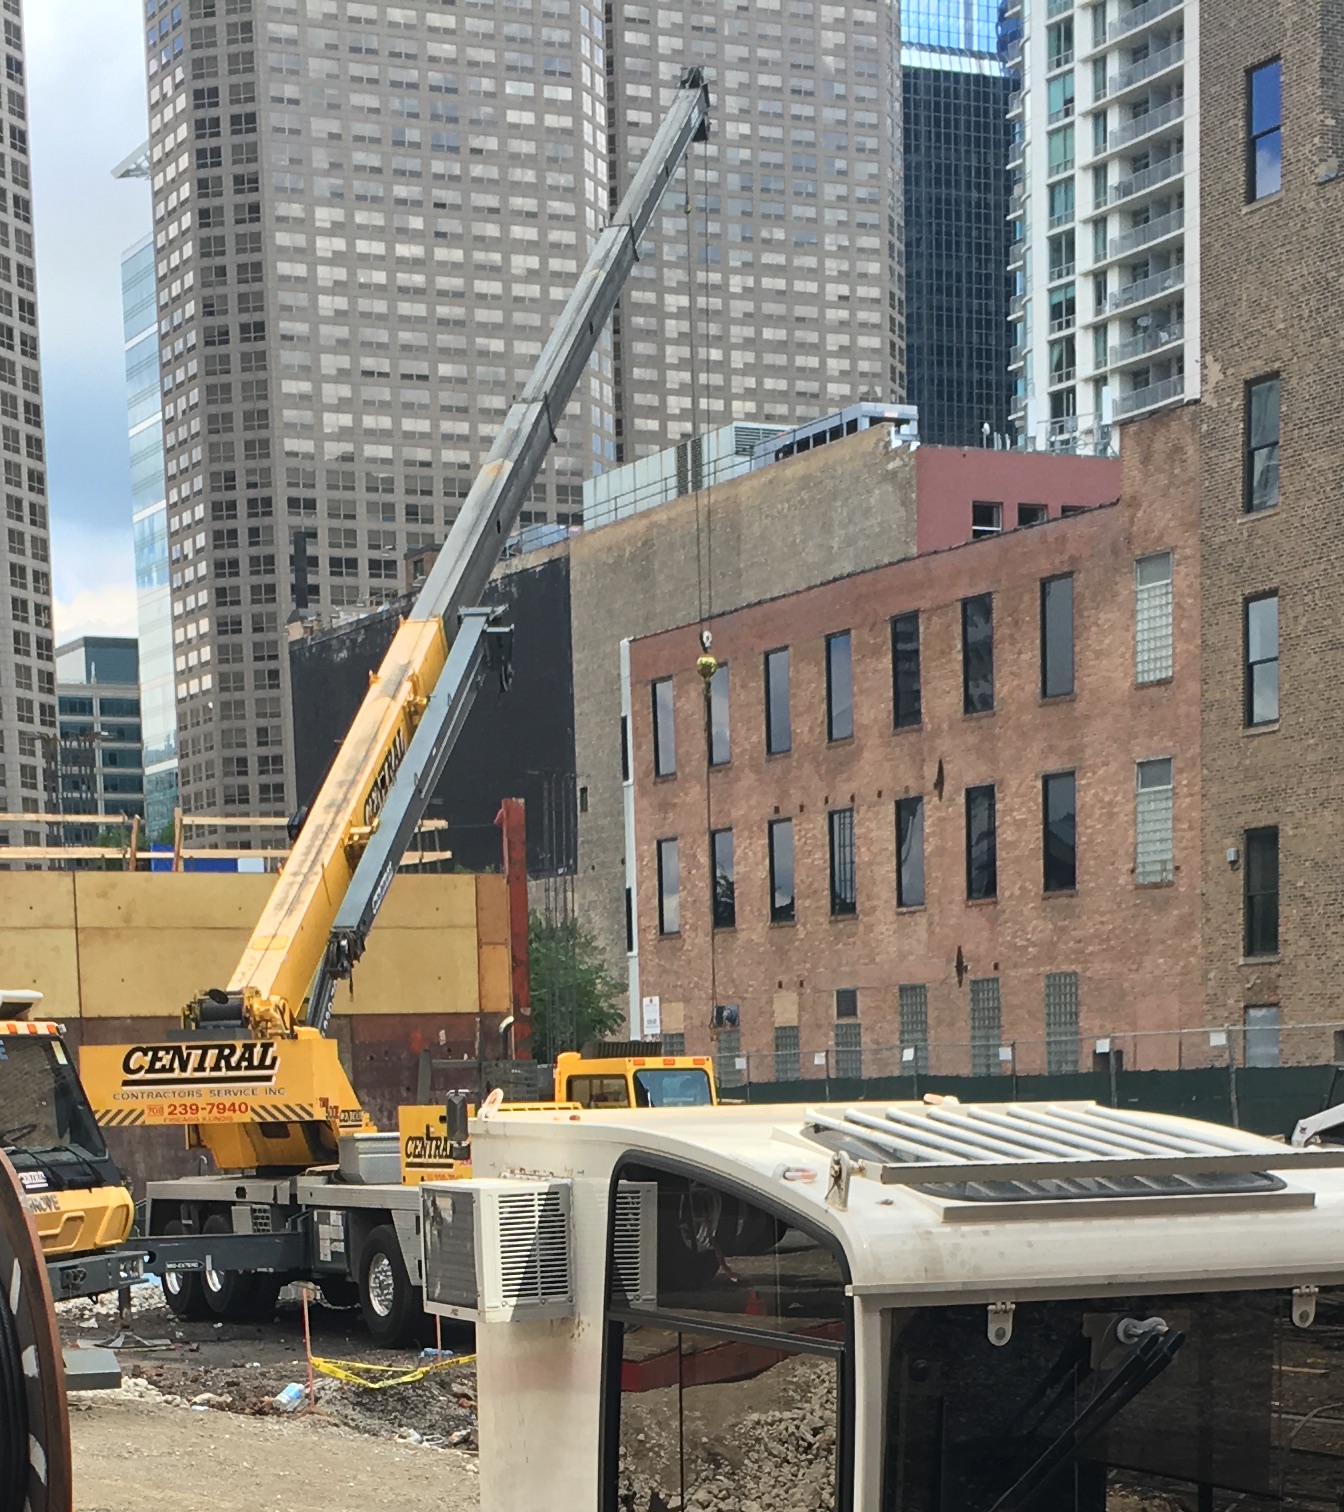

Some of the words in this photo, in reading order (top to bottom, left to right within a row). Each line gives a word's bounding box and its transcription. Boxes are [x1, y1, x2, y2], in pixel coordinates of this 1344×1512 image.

[122, 1042, 281, 1078] CENTRAL
[113, 1090, 203, 1101] CONTRACTORS
[209, 1088, 259, 1098] SERVICE
[167, 1102, 249, 1116] 239-7940
